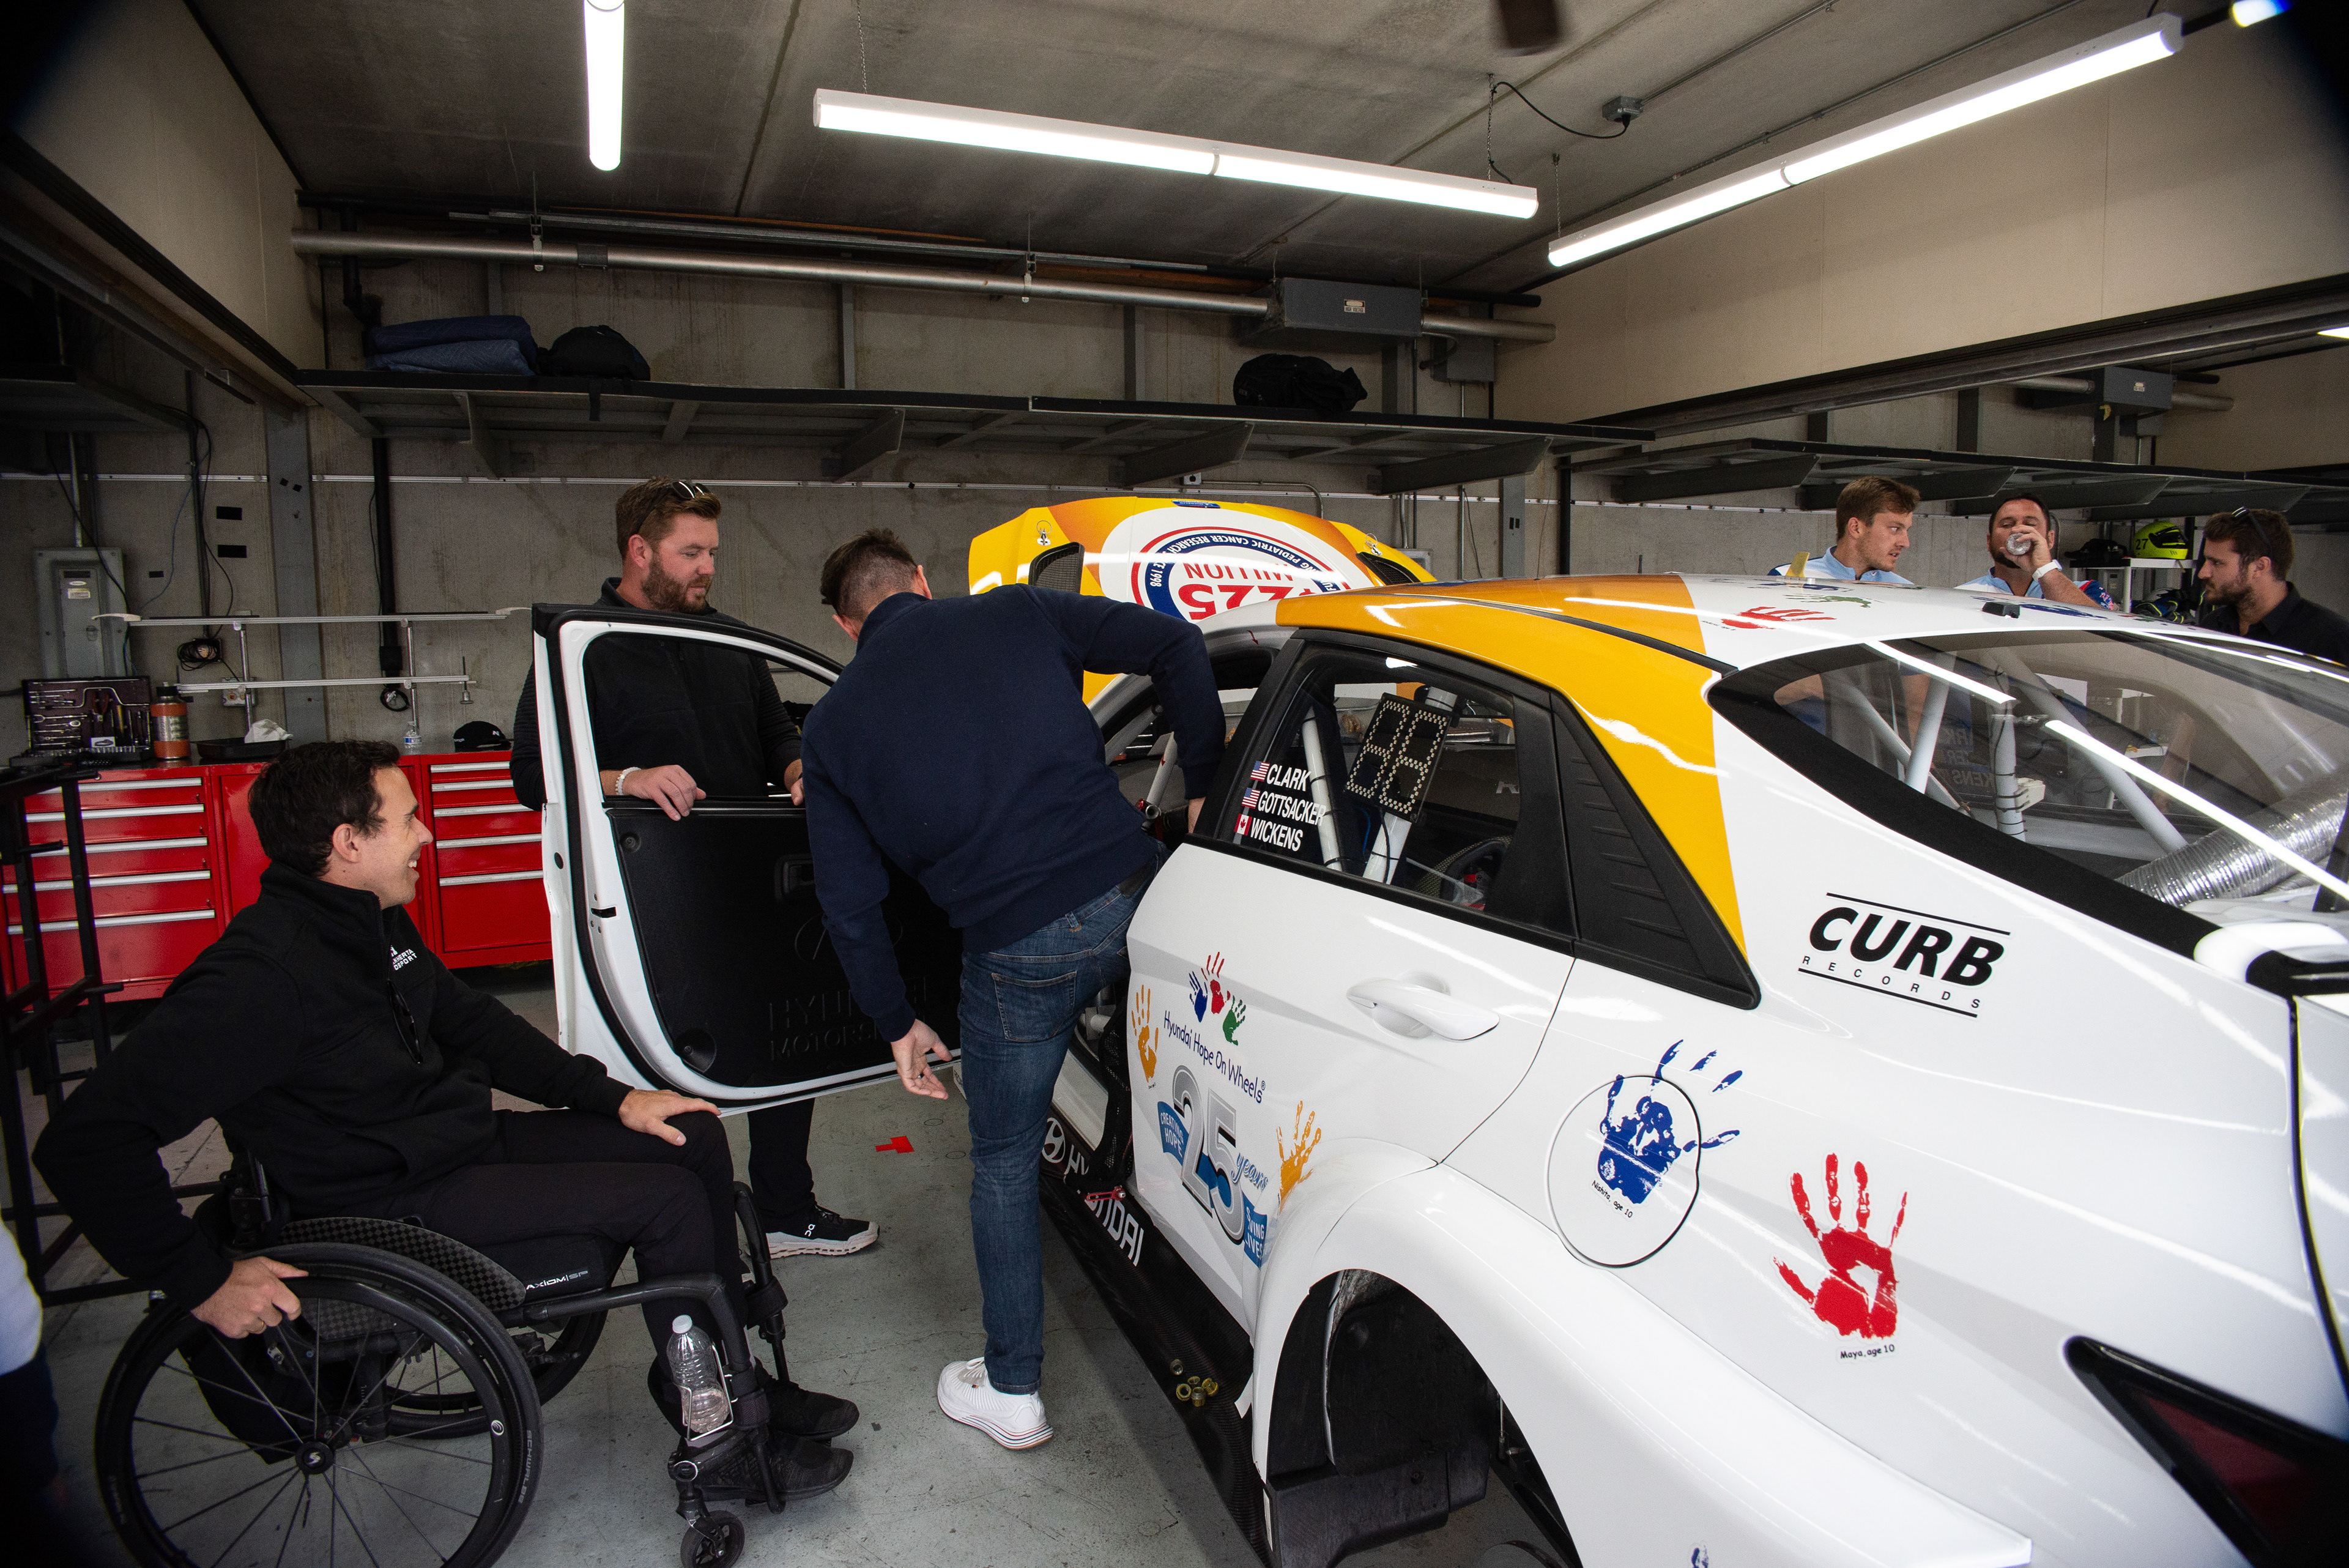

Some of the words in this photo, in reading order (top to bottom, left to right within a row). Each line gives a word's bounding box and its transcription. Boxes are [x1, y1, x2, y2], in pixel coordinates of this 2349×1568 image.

[1167, 535, 1211, 554] RESEARCH
[1210, 535, 1249, 547] CANCER
[1251, 540, 1301, 565] PEDIATRIC
[2135, 538, 2148, 550] 27
[1149, 570, 1163, 587] 1998
[1266, 763, 1311, 792] CLARK
[1258, 790, 1327, 827] GOTTSACKER
[1250, 819, 1304, 852] WICKENS
[1809, 906, 2005, 987] CURB
[1802, 955, 1981, 1009] RECORDS
[1163, 1010, 1192, 1049] Hyundai
[1193, 1036, 1214, 1065] Hope
[1215, 1051, 1227, 1076] On
[1159, 1111, 1184, 1145] CREATING
[1164, 1128, 1183, 1157] HOPE
[1172, 1065, 1245, 1246] 25
[1231, 1152, 1269, 1191] years
[1592, 1180, 1611, 1202] Nishita,
[1613, 1201, 1624, 1211] age
[1625, 1209, 1633, 1218] 10
[1246, 1206, 1264, 1240] SVING
[1840, 1350, 1866, 1360] Maya,
[1867, 1348, 1882, 1357] age
[1883, 1344, 1895, 1354] 10
[518, 1430, 532, 1504] SCHWALBE
